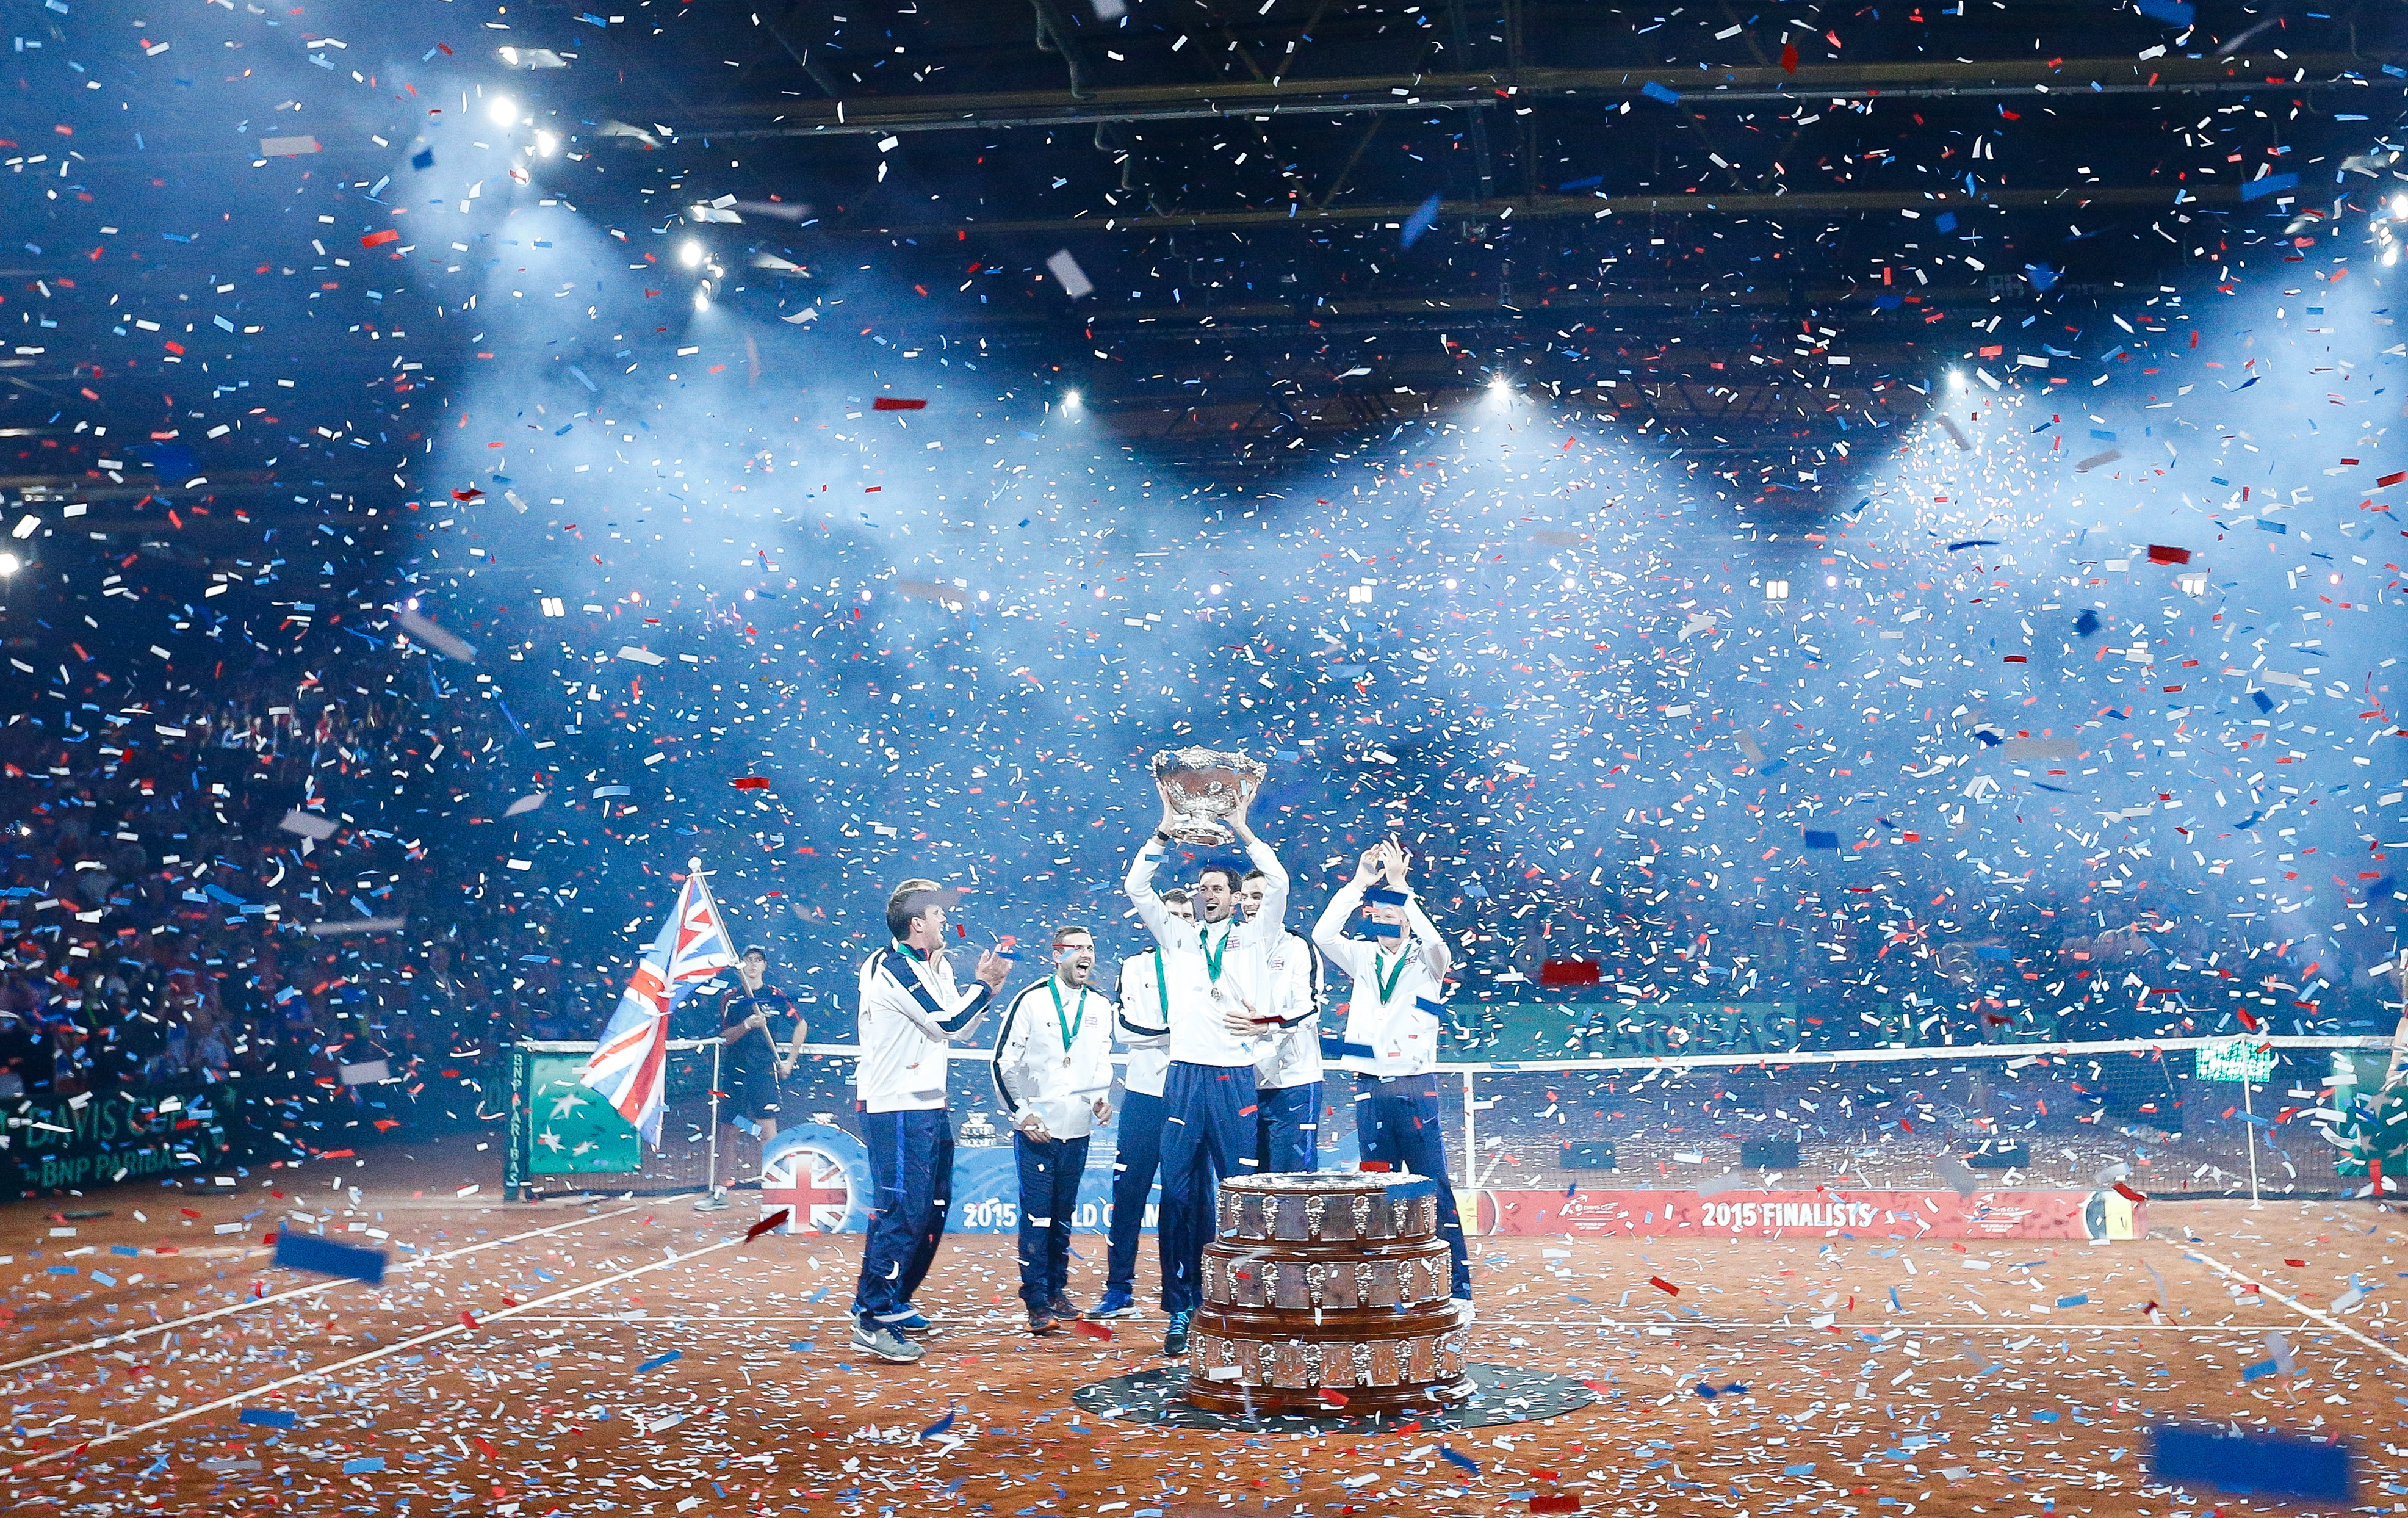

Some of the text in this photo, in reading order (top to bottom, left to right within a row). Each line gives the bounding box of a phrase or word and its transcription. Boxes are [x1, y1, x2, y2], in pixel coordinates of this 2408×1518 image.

[1438, 1011, 1795, 1055] NP PARIBAS
[512, 1053, 524, 1092] BNP
[26, 1095, 189, 1148] DAVIS CP
[41, 1157, 91, 1187] BNP
[95, 1149, 185, 1180] PARIBA
[963, 1202, 1017, 1227] 2015
[1701, 1202, 1872, 1227] 2015 FINALISTS
